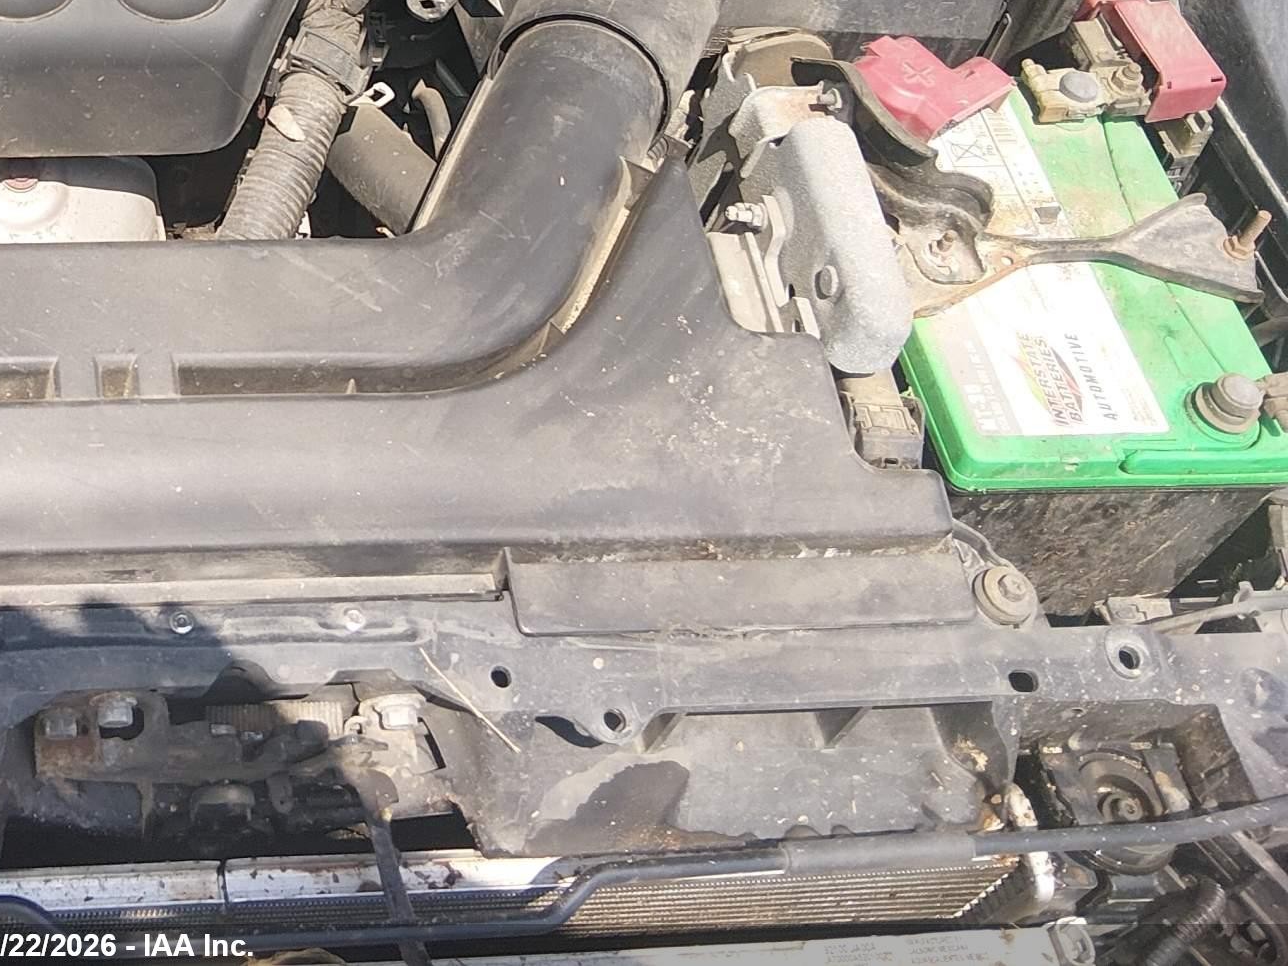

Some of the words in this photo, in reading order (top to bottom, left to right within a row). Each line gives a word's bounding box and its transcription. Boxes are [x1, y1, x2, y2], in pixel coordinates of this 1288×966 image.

[1017, 333, 1070, 427] INTERSTATE
[1034, 337, 1083, 423] BATTERIES
[1064, 333, 1119, 421] AUTOMOTIVE
